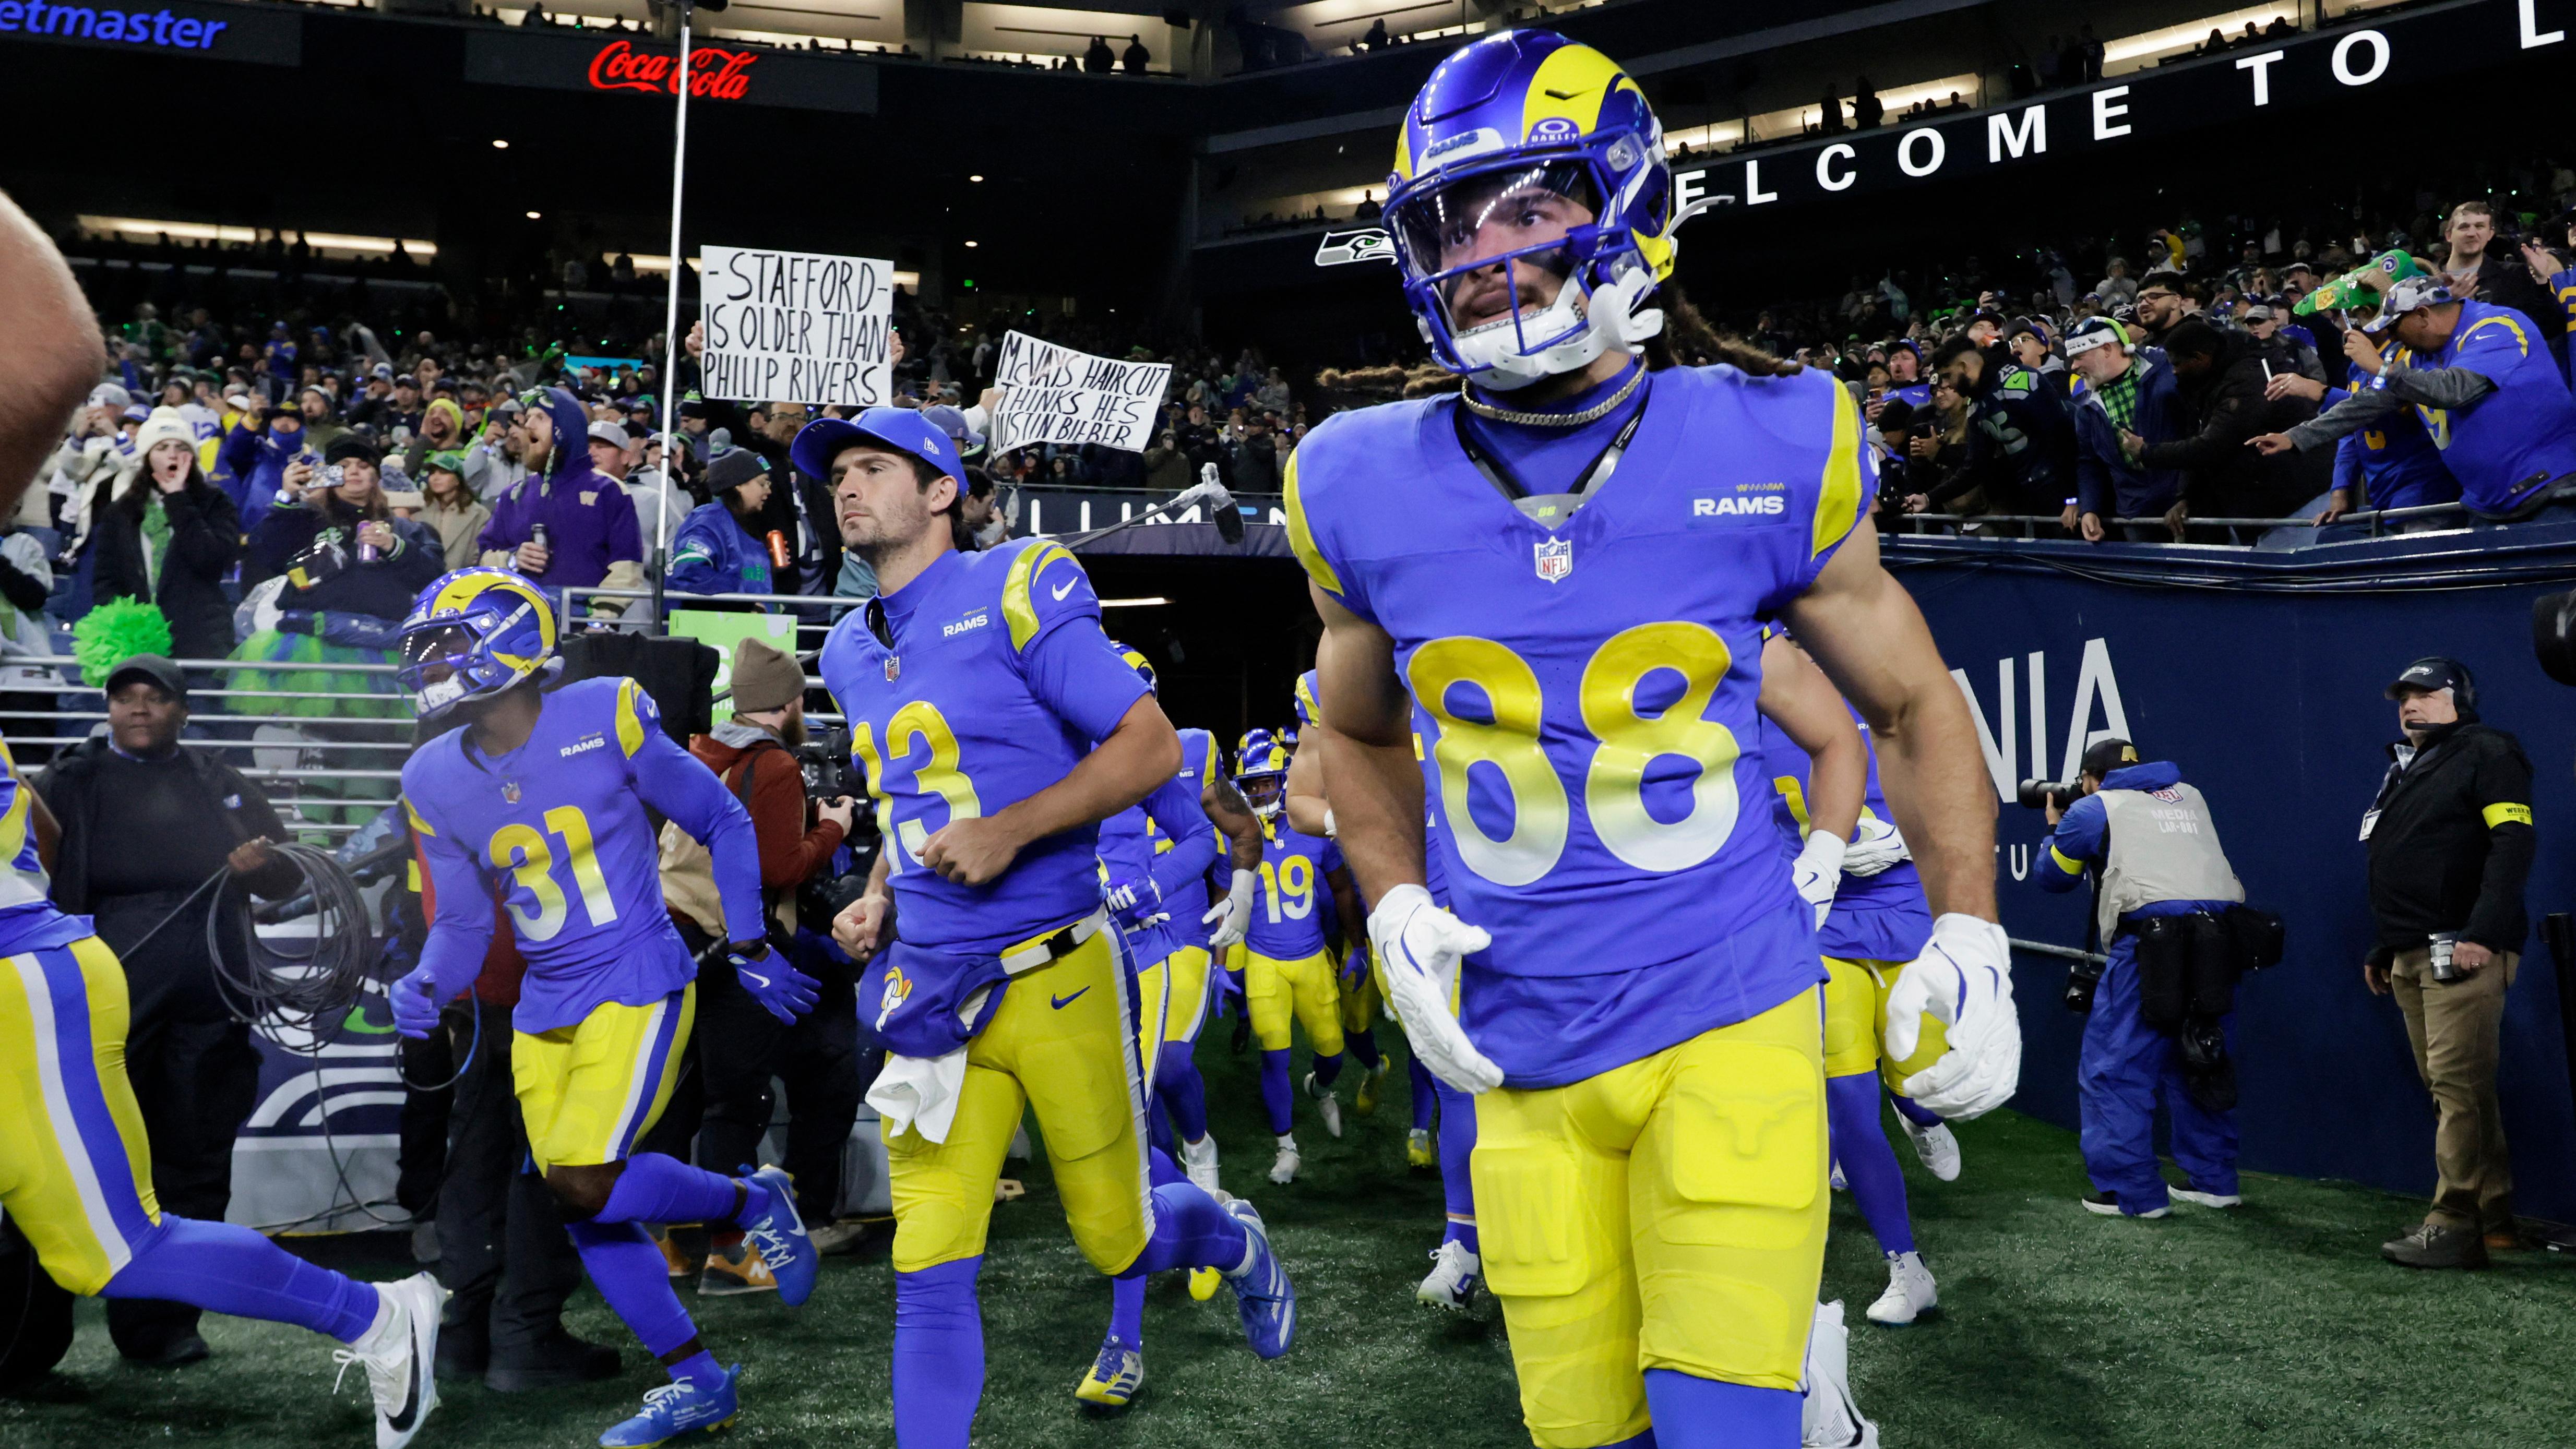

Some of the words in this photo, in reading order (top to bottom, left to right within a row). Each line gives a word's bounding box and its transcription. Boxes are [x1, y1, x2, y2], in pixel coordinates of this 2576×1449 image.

[588, 40, 759, 100] Coca-Cola
[1531, 133, 1578, 143] OAKLEY
[1675, 85, 2131, 215] ELCOME
[2236, 30, 2390, 106] TO
[1427, 130, 1479, 159] RAMS
[706, 303, 729, 349] IS
[740, 305, 812, 355] OLDER
[822, 311, 892, 364] THAN
[704, 352, 779, 398] PHILIP
[789, 357, 878, 405] RIVERS
[1080, 358, 1171, 397] HAIRCUT
[999, 382, 1085, 415] THINKS
[993, 411, 1057, 452] JUSTIN
[1055, 416, 1131, 446] BIEBER
[1693, 496, 1785, 516] RAMS
[1541, 557, 1567, 574] NFL
[943, 614, 988, 637] RAMS
[560, 737, 605, 758] RAMS
[1406, 620, 1740, 887] 88
[851, 700, 981, 876] 13
[2151, 809, 2199, 821] MEDIA
[489, 805, 618, 942] 31
[1258, 854, 1314, 924] 19
